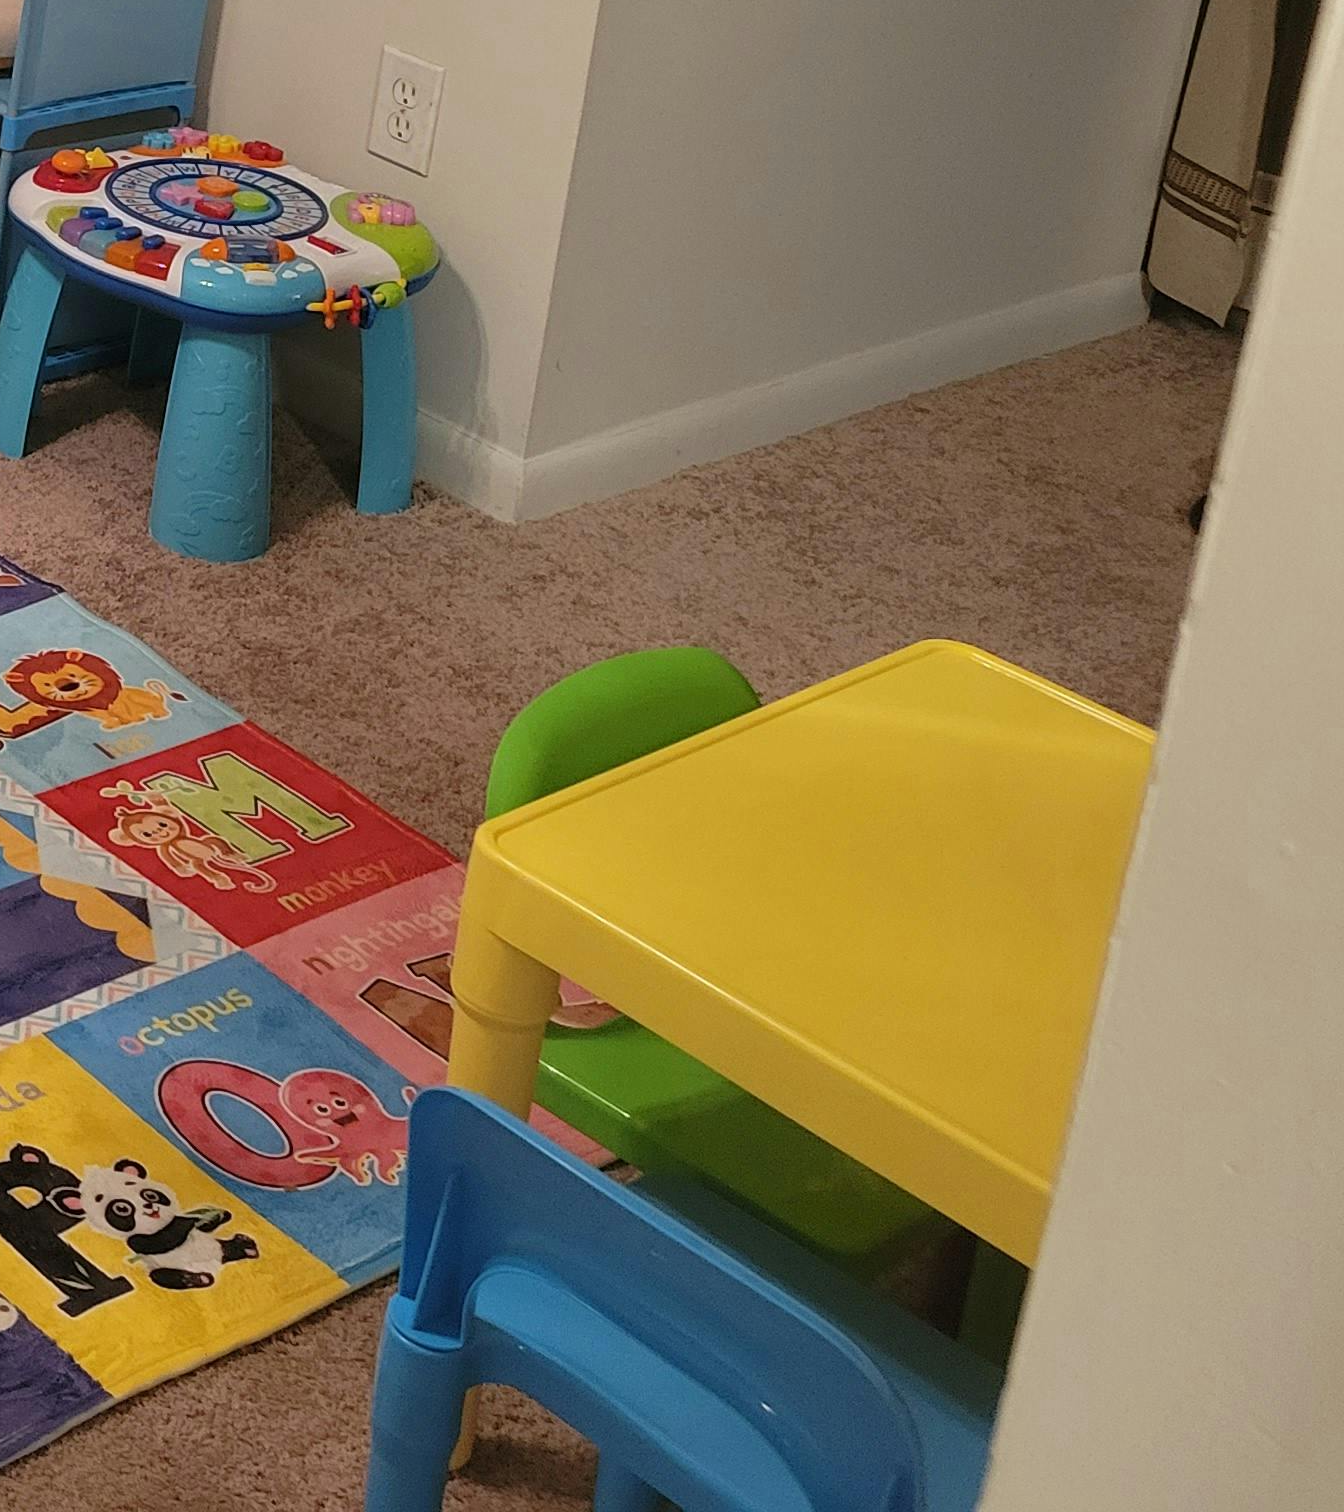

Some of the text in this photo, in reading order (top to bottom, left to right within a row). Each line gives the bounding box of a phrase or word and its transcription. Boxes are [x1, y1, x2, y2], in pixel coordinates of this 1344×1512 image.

[143, 751, 356, 866] M
[278, 858, 397, 913] monkey
[117, 985, 255, 1058] octopus
[155, 1056, 347, 1191] O
